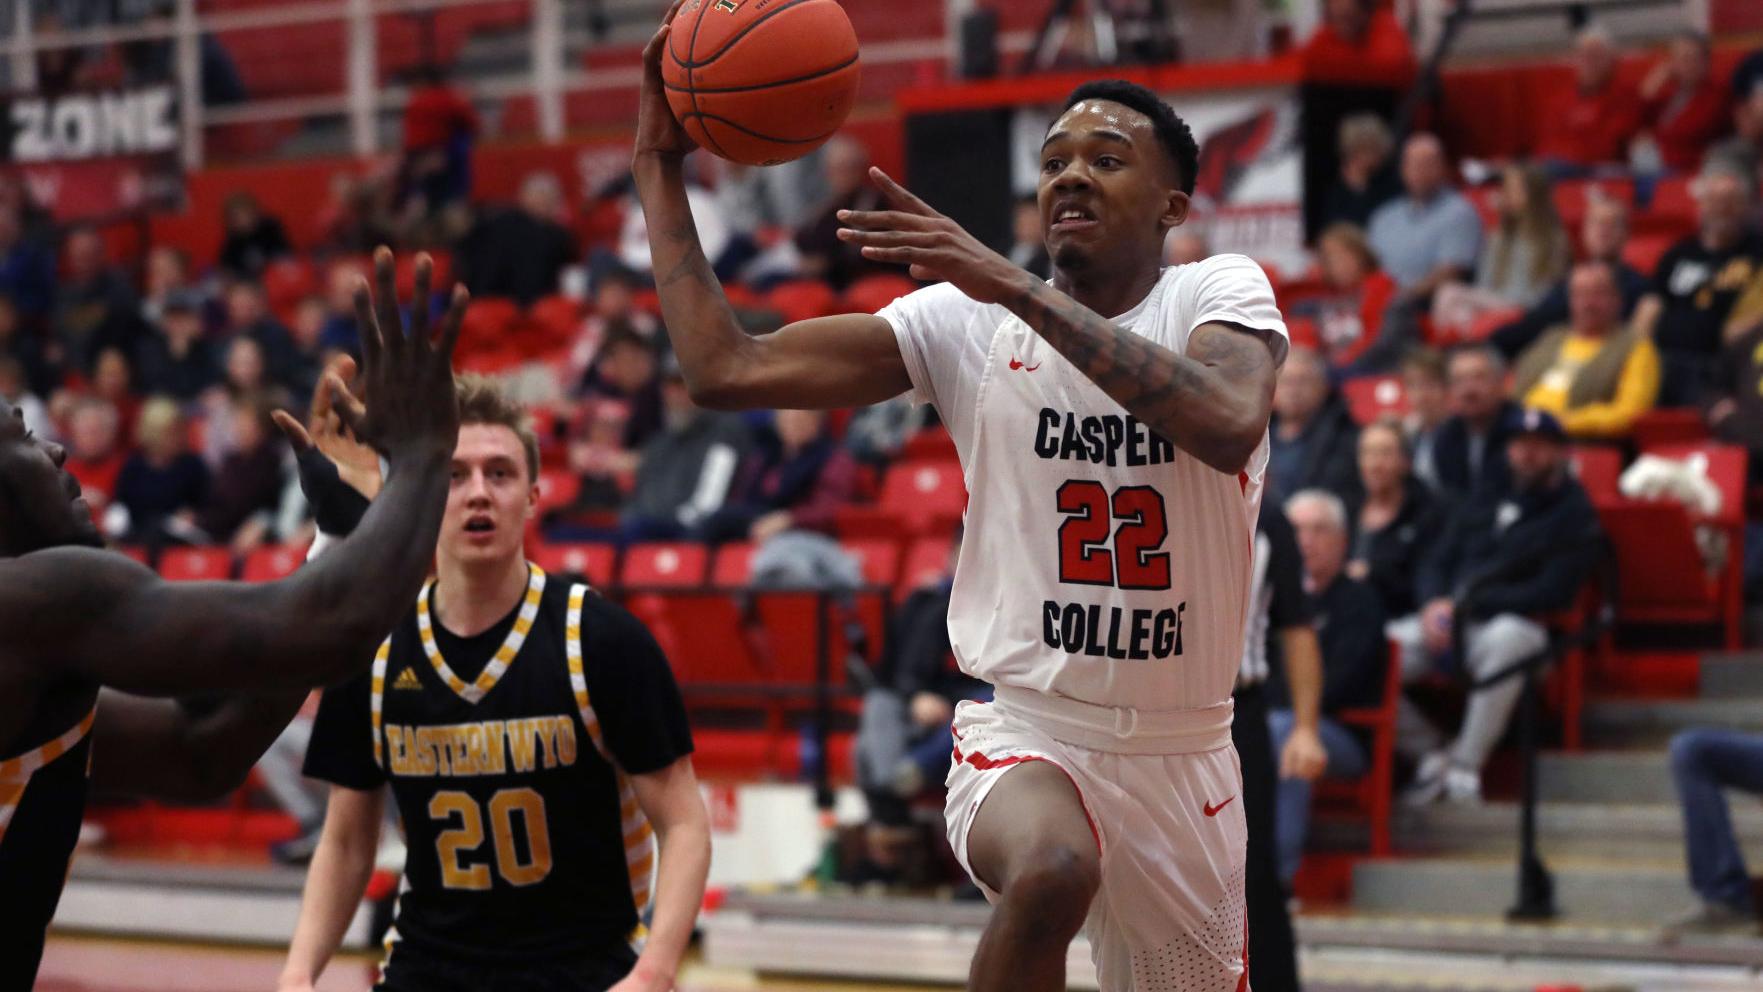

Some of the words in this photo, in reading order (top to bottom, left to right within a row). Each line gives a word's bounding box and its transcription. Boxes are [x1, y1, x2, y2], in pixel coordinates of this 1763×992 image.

[10, 85, 176, 163] ZONE
[1056, 479, 1171, 590] 22
[385, 720, 506, 776] EASTERN
[506, 714, 577, 773] WYO
[428, 787, 553, 890] 20
